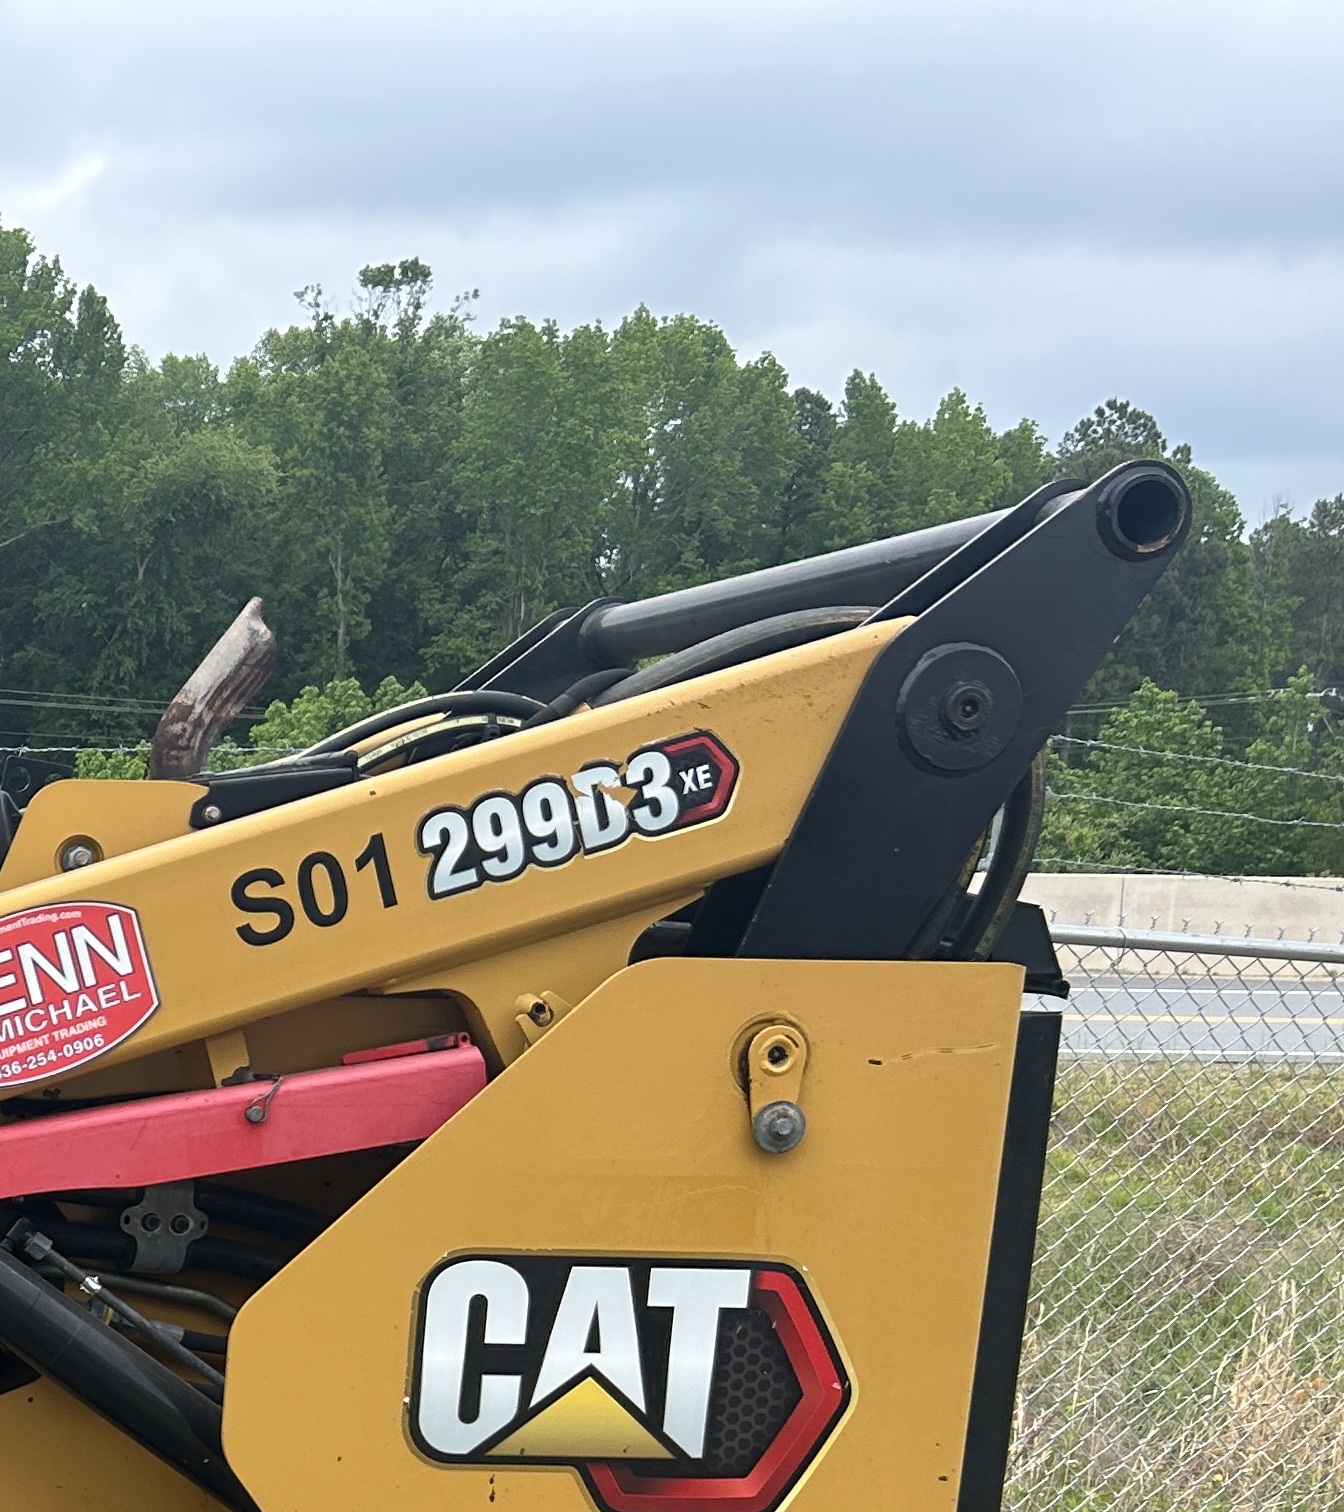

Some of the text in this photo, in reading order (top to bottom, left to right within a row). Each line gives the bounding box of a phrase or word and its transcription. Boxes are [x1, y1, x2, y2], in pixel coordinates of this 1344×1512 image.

[422, 751, 713, 894] 299D3 XE
[230, 833, 398, 947] S01
[52, 1016, 108, 1043] TRADING
[419, 1260, 751, 1459] CAT
